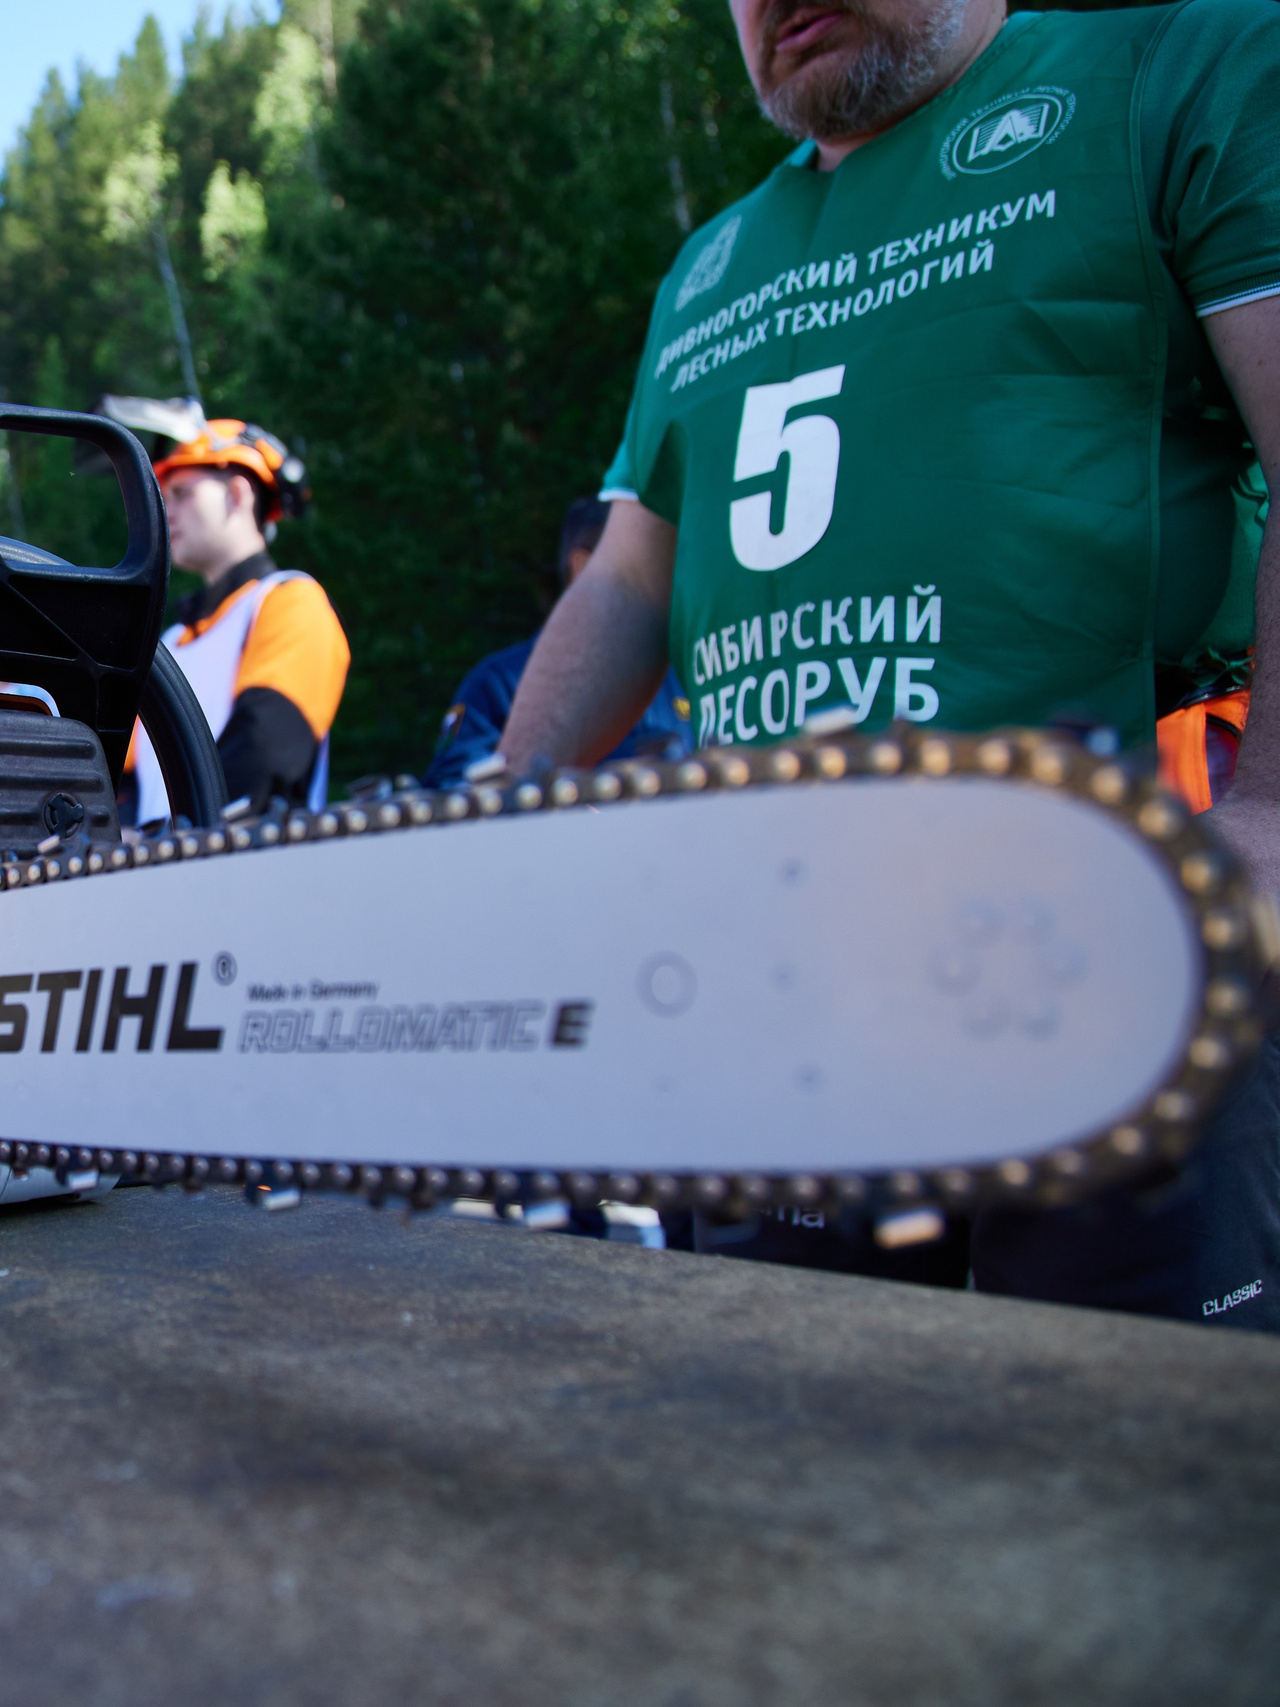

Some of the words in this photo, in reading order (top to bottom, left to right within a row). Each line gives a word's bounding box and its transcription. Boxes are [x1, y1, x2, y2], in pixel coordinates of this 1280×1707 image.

[654, 252, 858, 380] ДИВНОГОРСКИЙ
[867, 189, 1057, 275] ТЕХНИКУМ
[669, 317, 770, 393] ЛЕСНЫХ
[775, 238, 995, 336] ТЕХНОЛОГИЙ
[729, 363, 847, 572] 5
[692, 584, 942, 687] СИБИРСКИЙ
[698, 656, 940, 749] ЛЕСОРУБ
[238, 1001, 546, 1053] ROLLOMATIC
[550, 999, 596, 1050] E
[1202, 1279, 1263, 1316] CLASSIC
